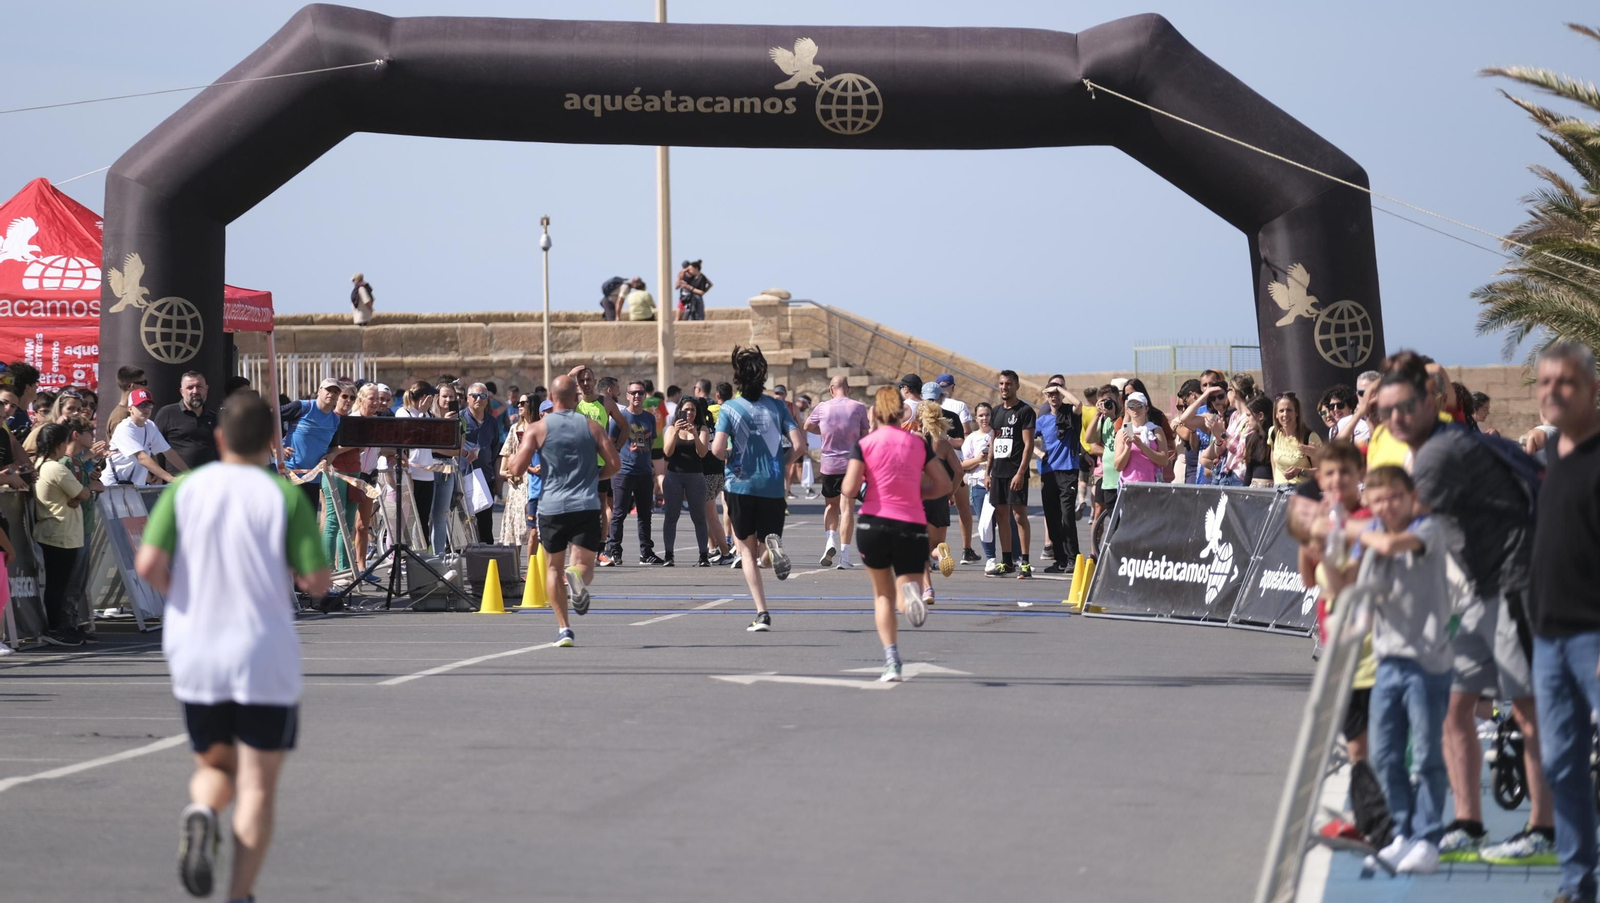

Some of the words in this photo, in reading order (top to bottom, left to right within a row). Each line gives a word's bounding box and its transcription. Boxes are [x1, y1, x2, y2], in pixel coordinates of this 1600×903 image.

[564, 87, 797, 117] aquéatacamos
[0, 299, 100, 317] acamos
[52, 341, 60, 372] evento
[1118, 551, 1210, 586] aquéatacamos
